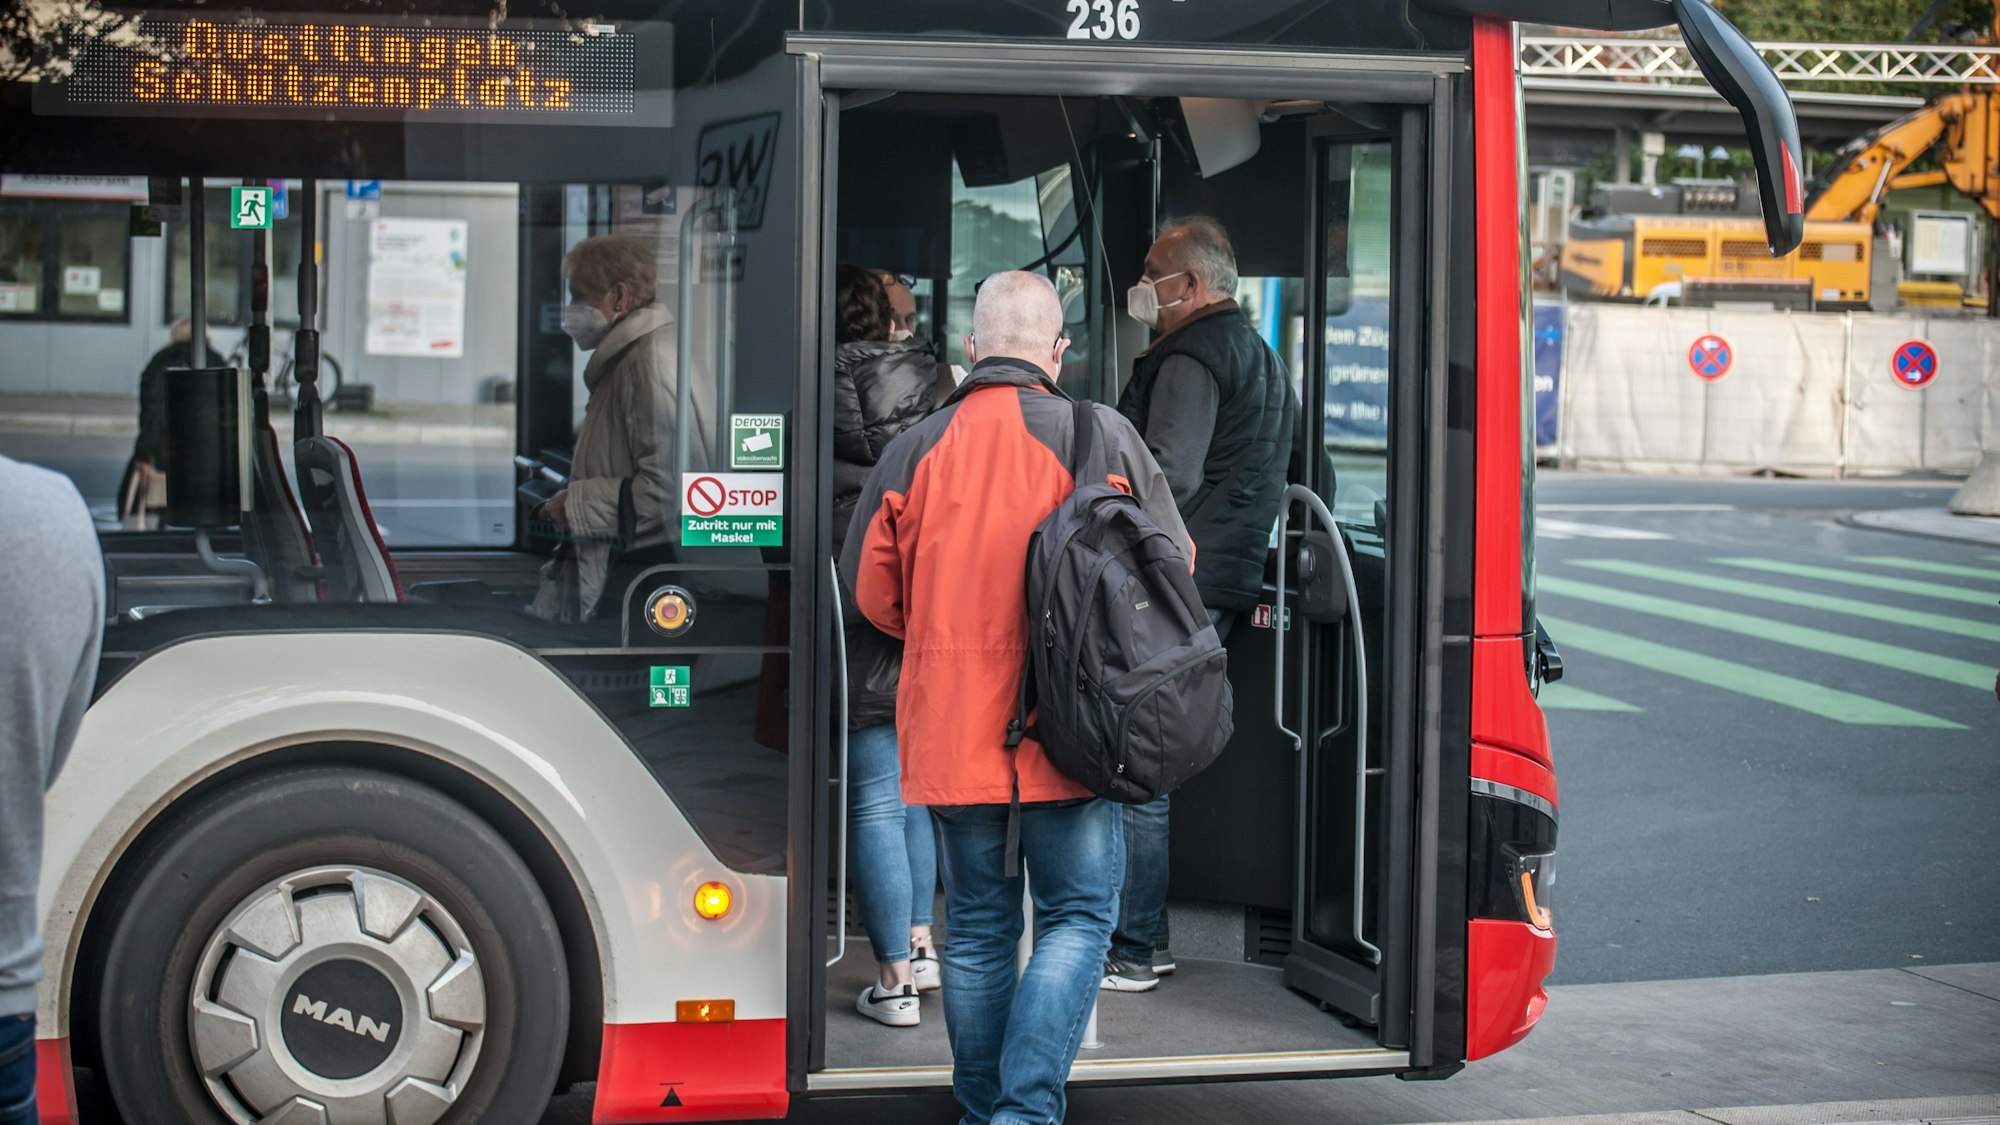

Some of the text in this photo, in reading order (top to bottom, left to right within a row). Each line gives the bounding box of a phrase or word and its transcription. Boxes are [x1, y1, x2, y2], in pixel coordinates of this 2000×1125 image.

[1066, 0, 1141, 40] 236
[186, 22, 516, 69] Quettingen
[134, 62, 570, 110] Schützenplatz
[728, 490, 777, 506] STOP
[688, 520, 777, 531] Zutritt nur mit
[711, 532, 754, 543] Maske!
[293, 994, 391, 1042] MAN
